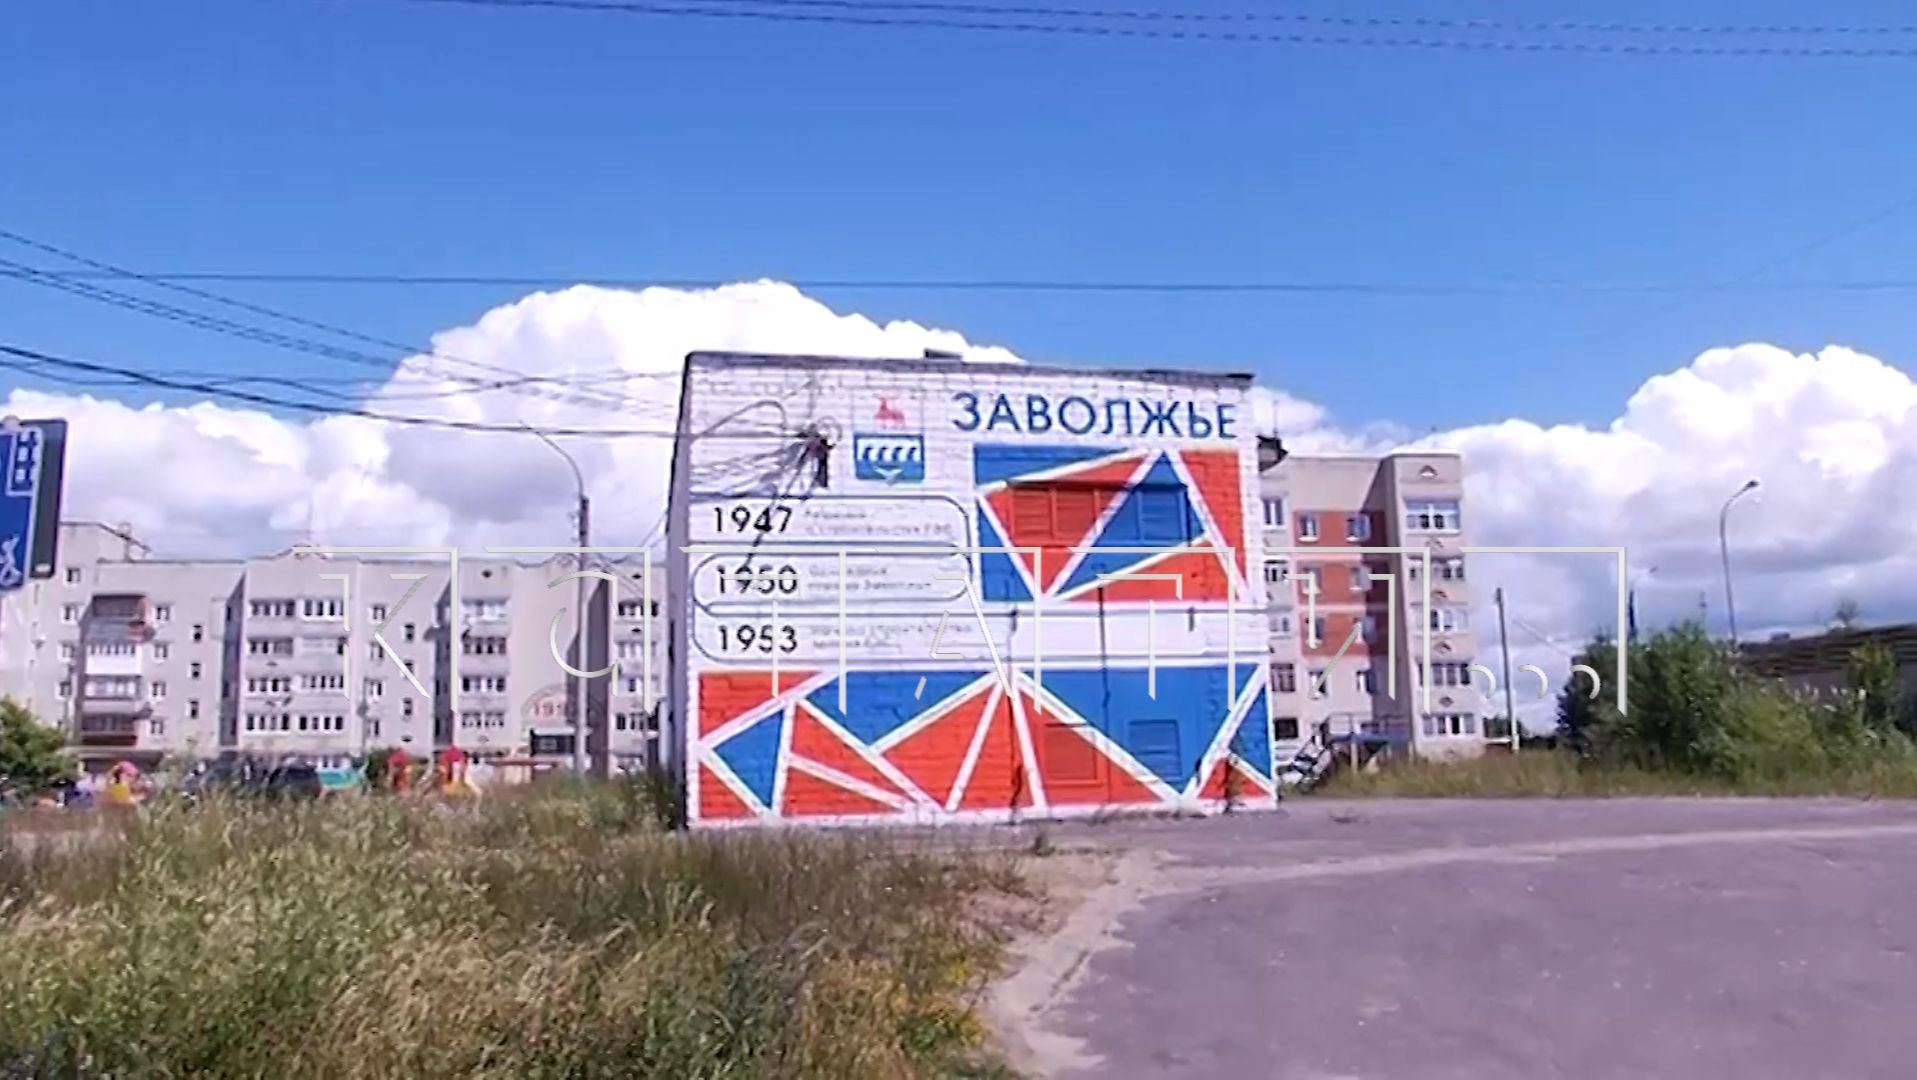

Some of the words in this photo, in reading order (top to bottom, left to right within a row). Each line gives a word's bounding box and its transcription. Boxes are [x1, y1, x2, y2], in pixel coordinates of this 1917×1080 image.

[952, 392, 1238, 439] ЗАВОЛЖЬЕ
[714, 506, 792, 533] 1947
[717, 563, 798, 594] 1950
[718, 625, 798, 654] 1953
